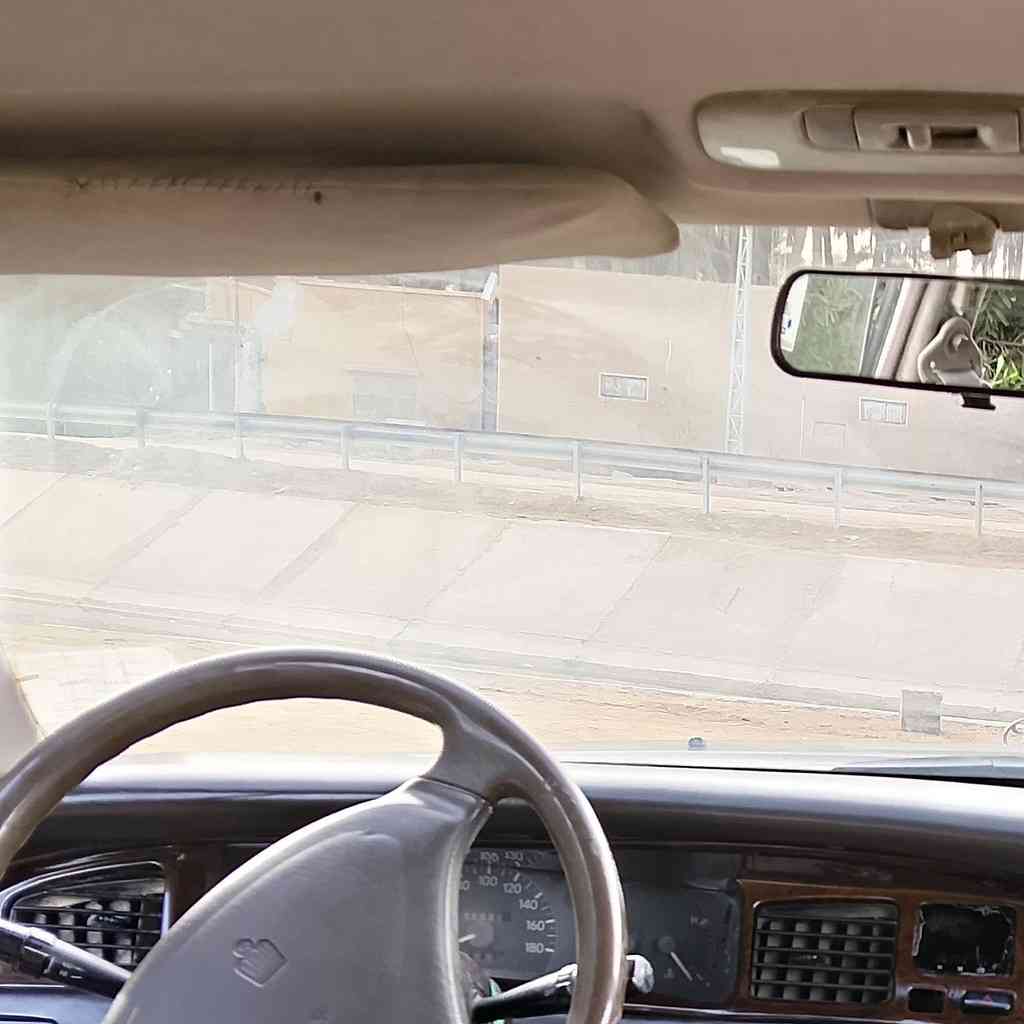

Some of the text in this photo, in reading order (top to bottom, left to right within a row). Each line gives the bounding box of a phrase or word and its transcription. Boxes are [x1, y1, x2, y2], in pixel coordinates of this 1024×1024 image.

[480, 875, 498, 888] 100
[503, 882, 522, 895] 120
[520, 899, 539, 911] 140
[526, 920, 546, 932] 160
[525, 942, 545, 954] 180
